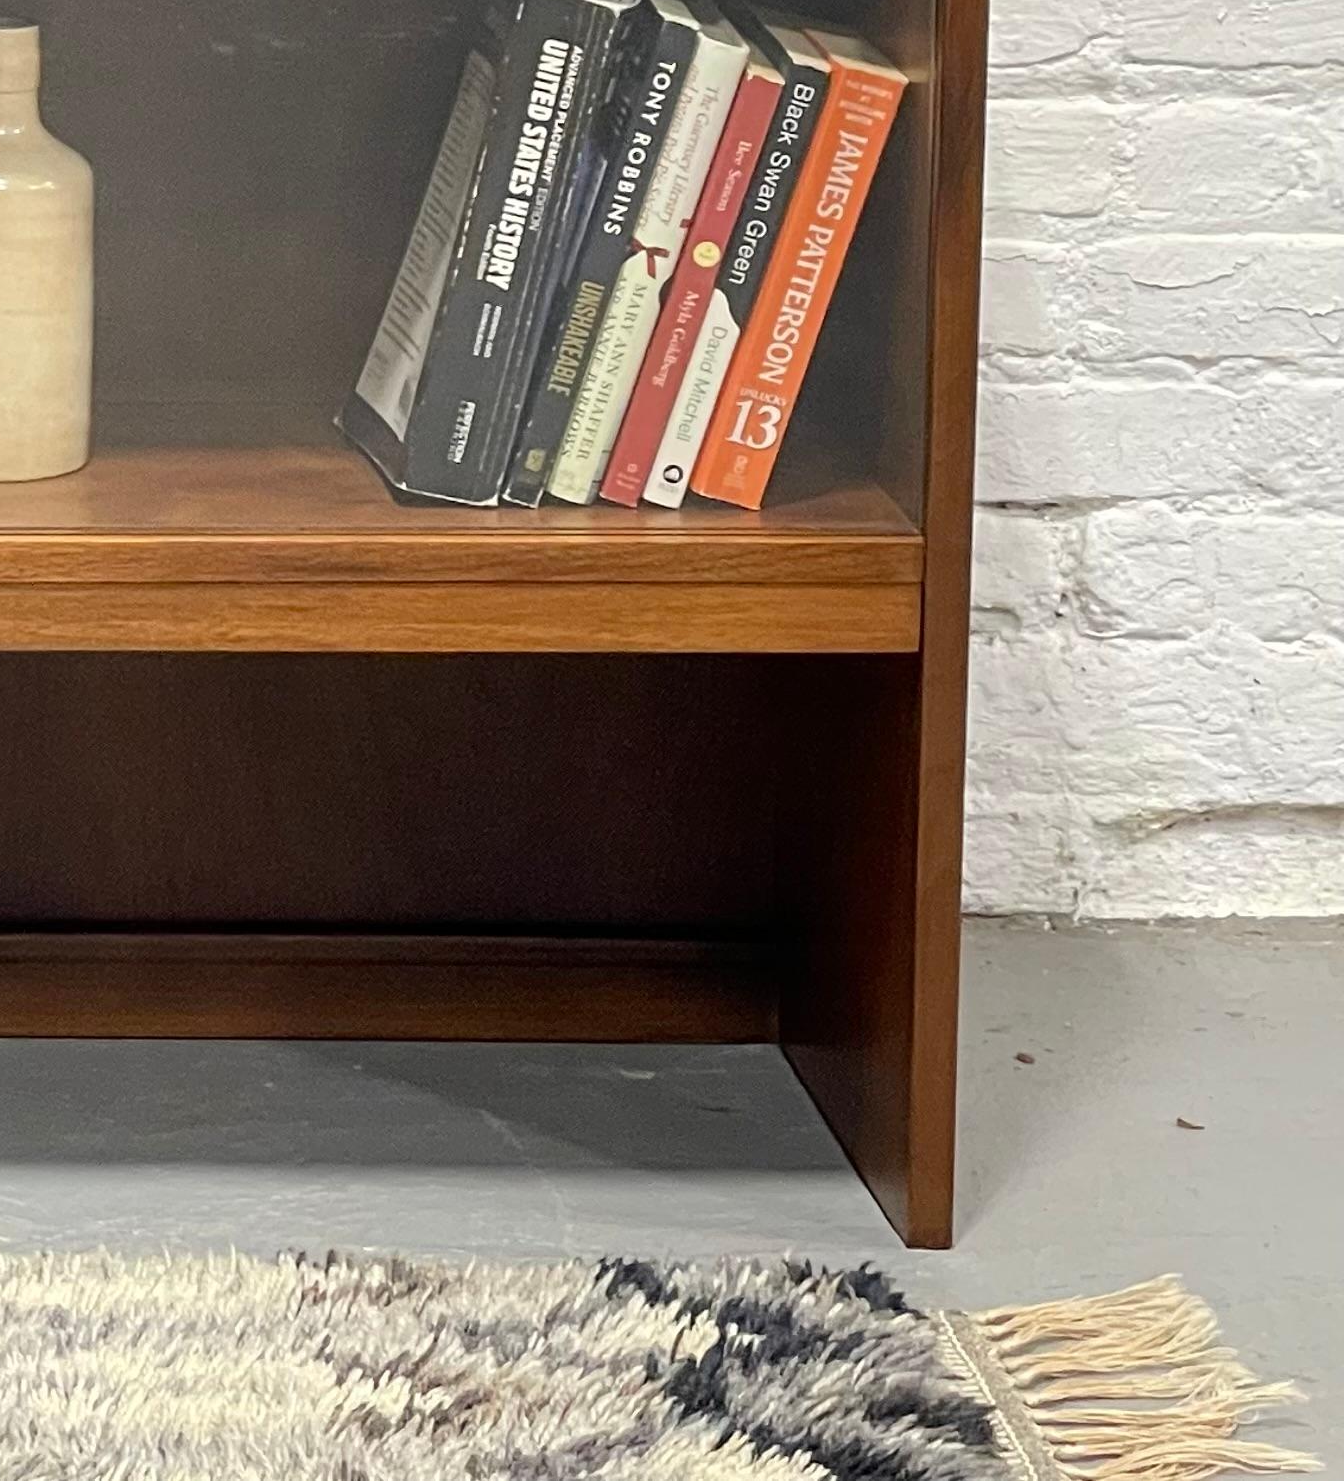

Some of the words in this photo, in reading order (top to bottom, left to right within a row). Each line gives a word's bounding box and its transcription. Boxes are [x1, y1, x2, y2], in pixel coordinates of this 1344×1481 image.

[527, 38, 570, 123] UNITED
[558, 44, 584, 110] ADVANCED
[640, 61, 677, 127] TONY
[700, 85, 719, 112] The
[678, 112, 710, 170] Guernsey
[776, 82, 815, 146] Black
[508, 121, 548, 198] STATES
[541, 110, 568, 183] PLACEMENT
[733, 139, 753, 167] Bee
[815, 129, 869, 221] JAMES
[528, 188, 549, 232] EDITION
[603, 131, 653, 237] ROBBINS
[661, 173, 690, 226] Literary
[715, 168, 743, 213] Season
[754, 150, 792, 213] Swan
[485, 197, 530, 292] HISTORY
[728, 219, 768, 288] Green
[620, 283, 648, 335] MARY
[676, 290, 701, 326] Myla
[758, 223, 836, 386] PATTERSON
[547, 280, 606, 398] UNSHAKEABLE
[605, 337, 628, 377] ANN
[652, 326, 687, 389] Goldberg
[703, 325, 729, 376] David
[575, 382, 614, 461] SHAFFER
[677, 376, 713, 444] Mitchell
[724, 398, 782, 450] 13
